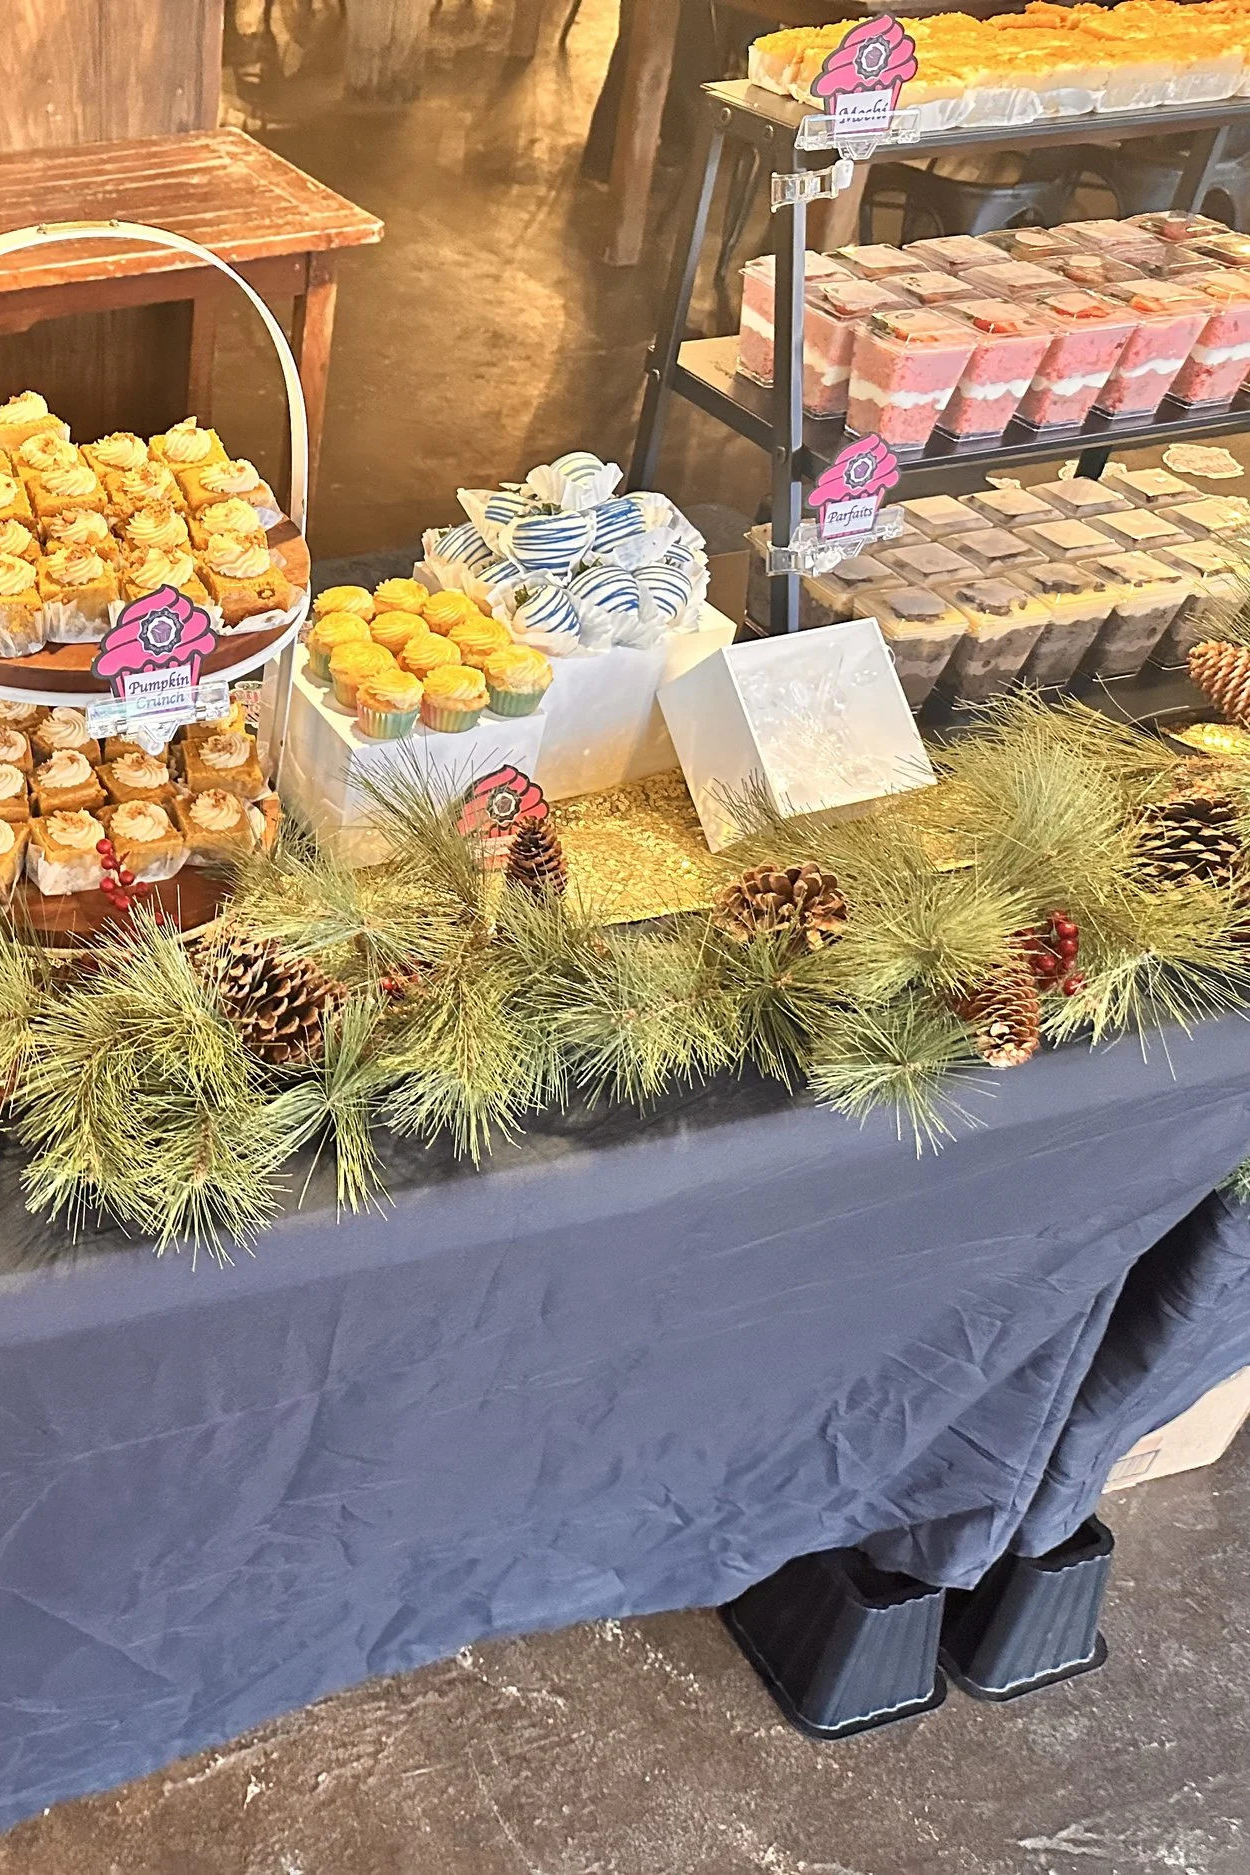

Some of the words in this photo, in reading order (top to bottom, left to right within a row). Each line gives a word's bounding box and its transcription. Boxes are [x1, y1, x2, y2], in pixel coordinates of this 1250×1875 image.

[826, 504, 874, 527] Parfaits
[128, 671, 190, 696] Pumpkin
[136, 692, 185, 710] Crunch
